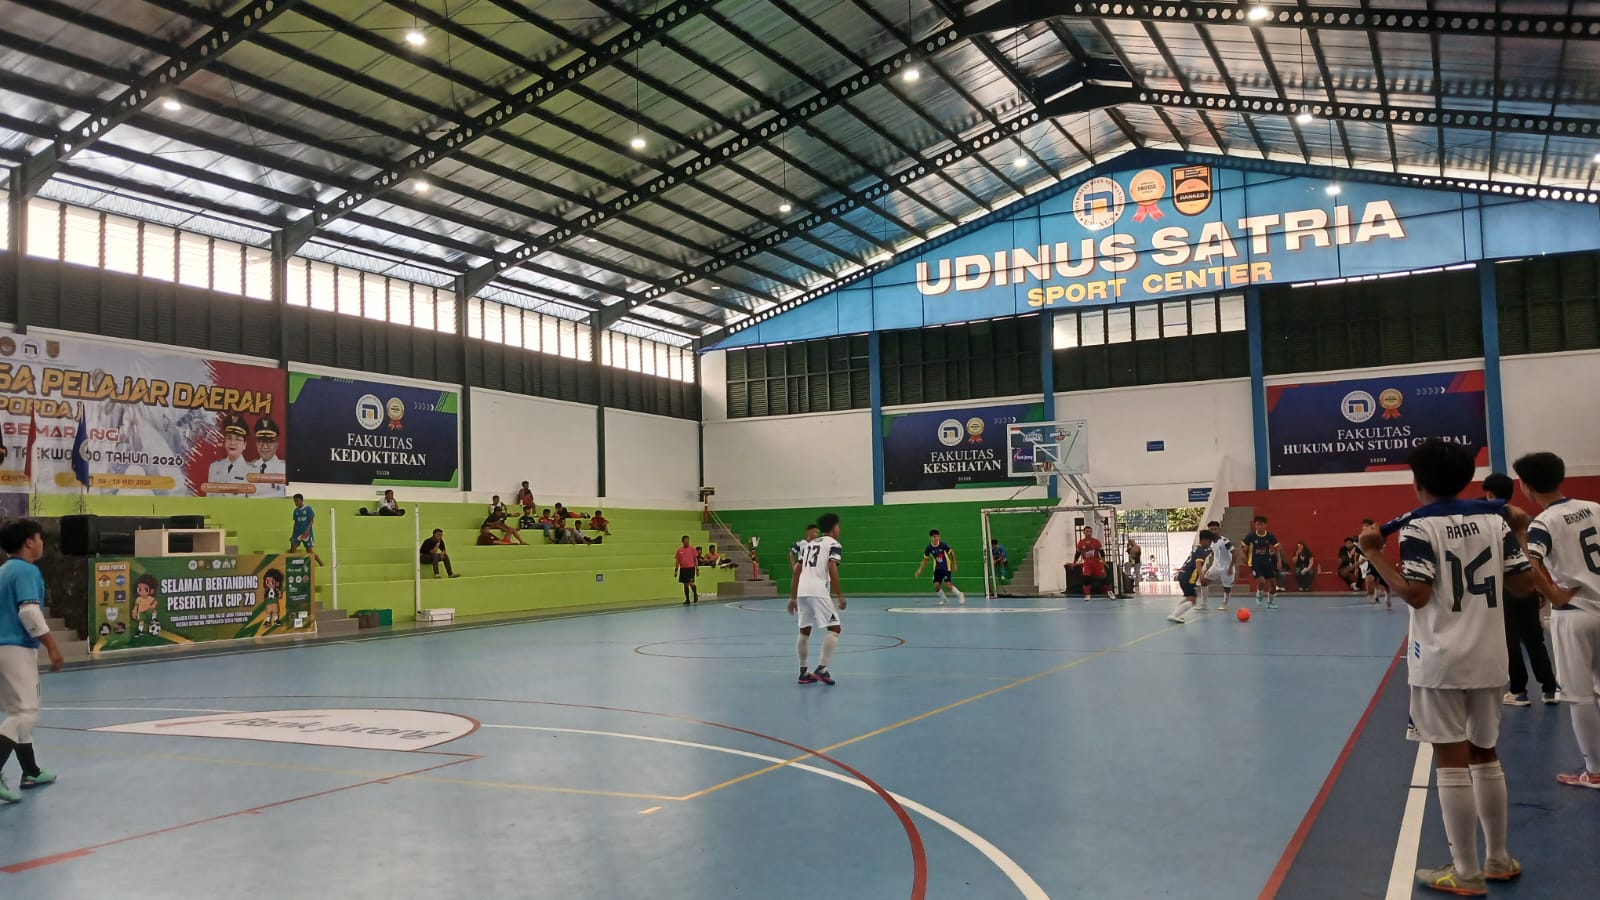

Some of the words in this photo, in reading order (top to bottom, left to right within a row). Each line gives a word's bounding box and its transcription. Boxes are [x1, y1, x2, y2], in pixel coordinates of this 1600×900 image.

[1179, 192, 1206, 201] RANKED
[916, 233, 1138, 297] UDINUS
[1151, 199, 1406, 268] SATRIA
[1027, 277, 1126, 307] SPORT
[1143, 260, 1273, 295] CENTER
[41, 367, 168, 407] PELAJAR
[172, 381, 273, 415] DAERAH
[2, 421, 119, 441] SEMARNG
[1337, 425, 1411, 440] FAKULTAS
[347, 432, 413, 450] FAKULTAS
[1283, 442, 1333, 455] HUKUM
[1336, 440, 1365, 453] DAN
[1367, 438, 1408, 451] STUDI
[106, 450, 149, 465] TAHUN
[152, 454, 183, 466] 2026
[330, 447, 427, 466] KEDOKTERAN
[931, 448, 994, 462] FAKULTAS
[923, 459, 1001, 474] KESEHATAN
[805, 545, 821, 568] 13
[1579, 526, 1600, 576] 6
[161, 577, 203, 594] SELAMAT
[205, 575, 258, 591] BERTANDING
[1445, 545, 1498, 613] 14
[167, 594, 207, 611] PESERTA
[208, 593, 223, 608] FIX
[225, 592, 242, 607] CUP
